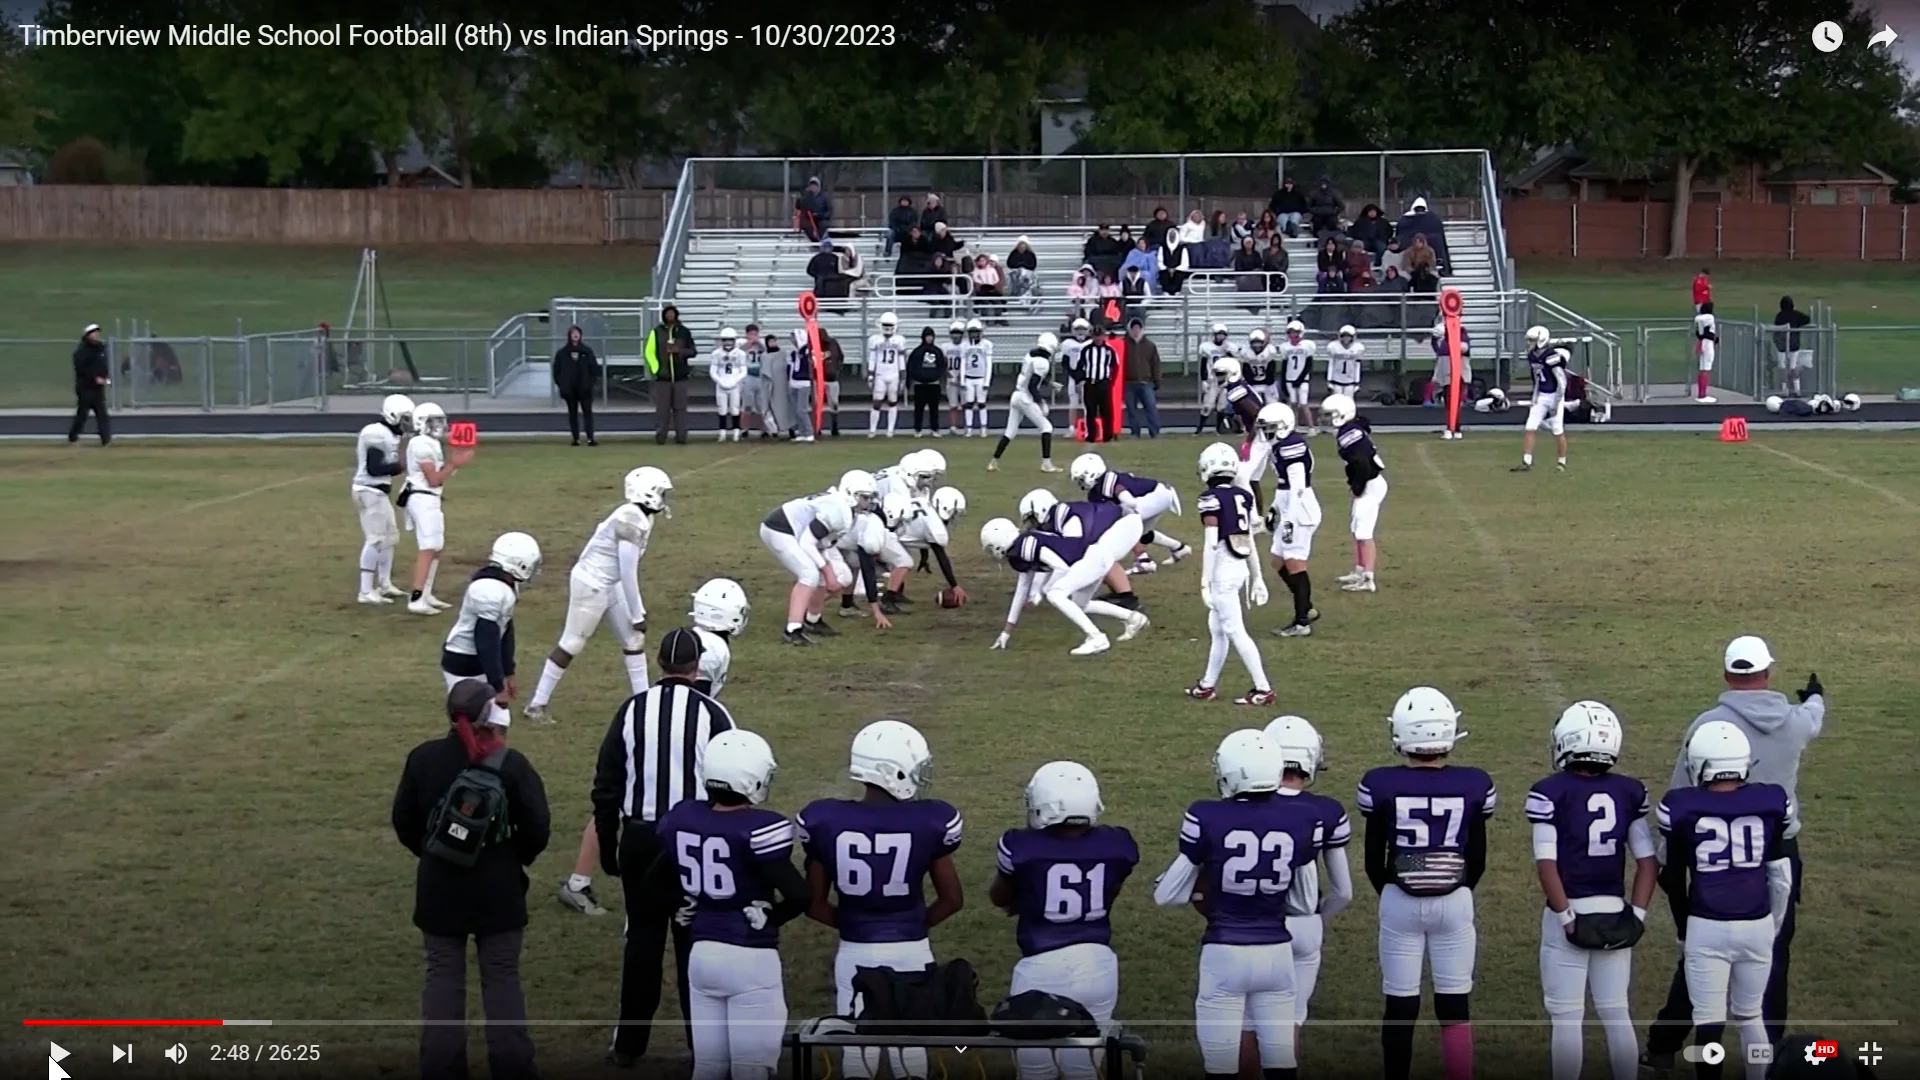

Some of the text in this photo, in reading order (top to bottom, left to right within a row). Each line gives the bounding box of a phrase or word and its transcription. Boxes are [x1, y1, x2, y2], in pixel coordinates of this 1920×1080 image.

[881, 349, 895, 364] 13
[948, 356, 961, 371] 10
[971, 354, 979, 368] 2
[452, 424, 473, 443] 40
[1730, 420, 1746, 439] 40
[1394, 796, 1465, 848] 57
[1587, 793, 1617, 857] 2
[1694, 815, 1766, 873] 20
[675, 830, 737, 900] 56
[835, 830, 912, 898] 67
[1221, 829, 1294, 896] 23
[1043, 862, 1108, 923] 61
